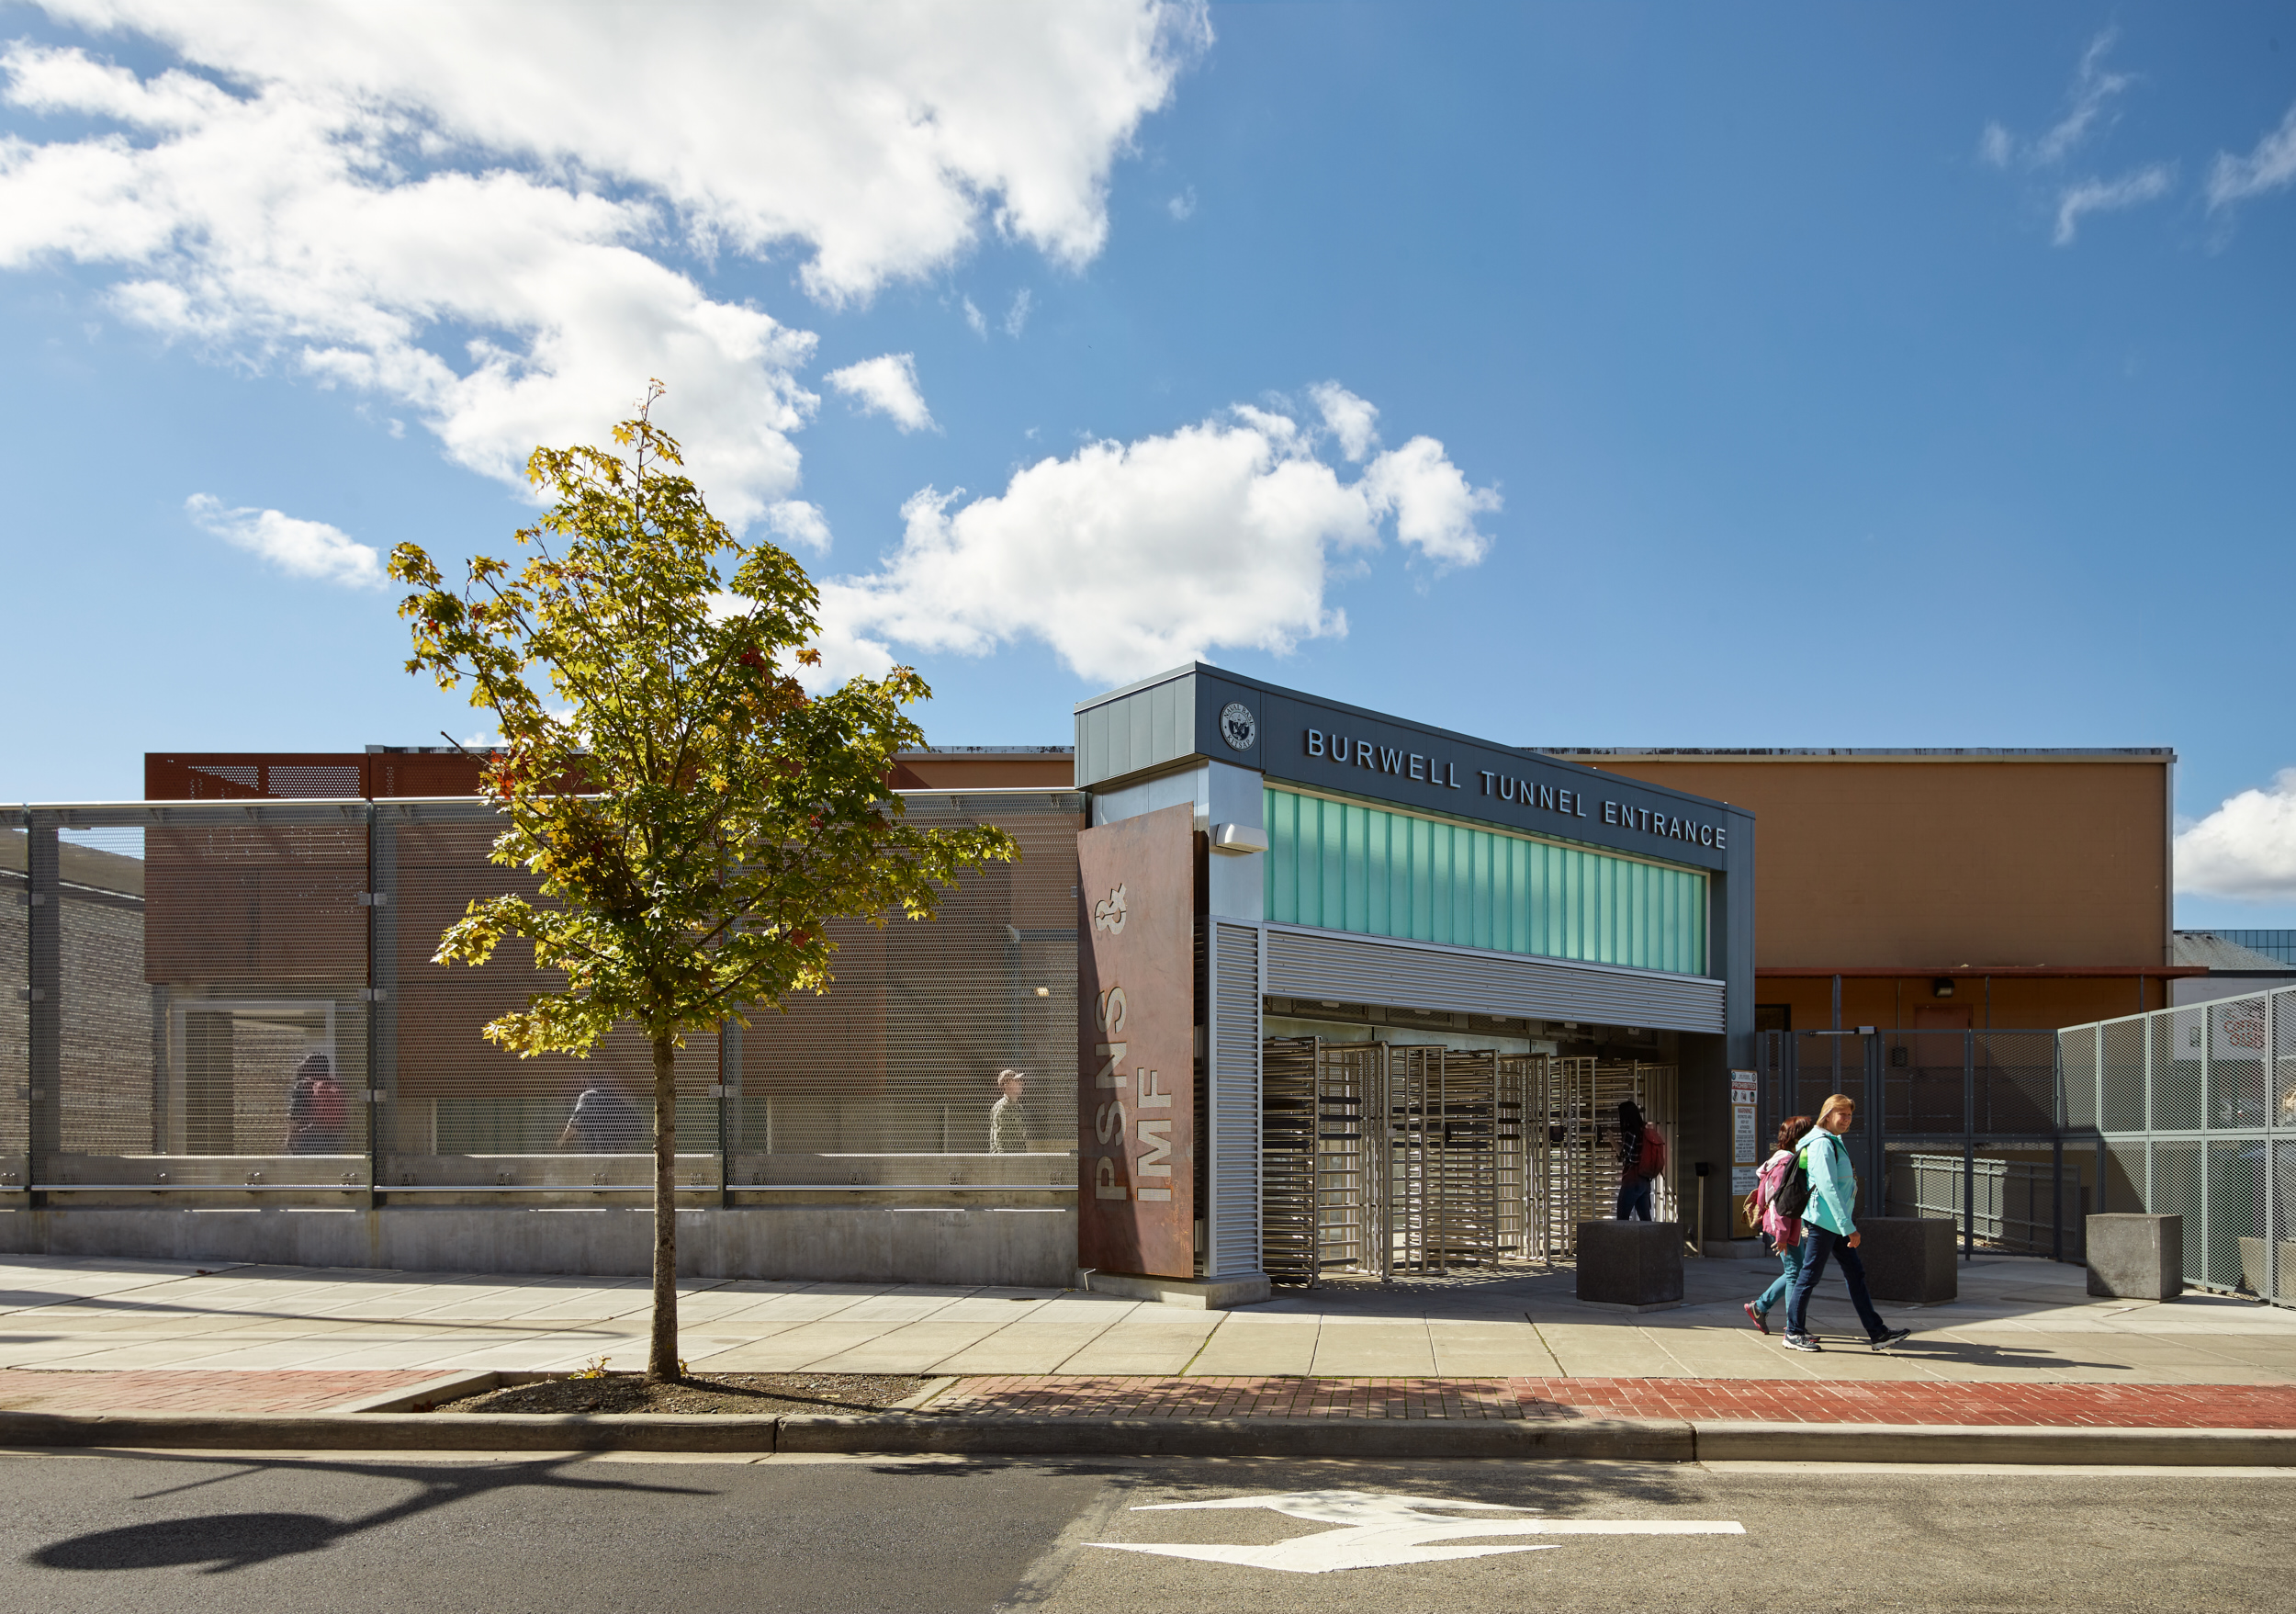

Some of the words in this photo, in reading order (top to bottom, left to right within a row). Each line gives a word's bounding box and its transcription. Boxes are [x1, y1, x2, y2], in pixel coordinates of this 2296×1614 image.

[1223, 704, 1241, 719] NAVAL
[1242, 706, 1255, 727] BASE
[1226, 734, 1251, 749] KITSAP
[1305, 728, 1461, 789] BURWELL
[1479, 770, 1586, 818] TUNNEL
[1603, 799, 1727, 850] ENTRANCE
[1095, 882, 1127, 935] &
[1095, 986, 1127, 1202] PSNS
[1136, 1067, 1172, 1202] IMF
